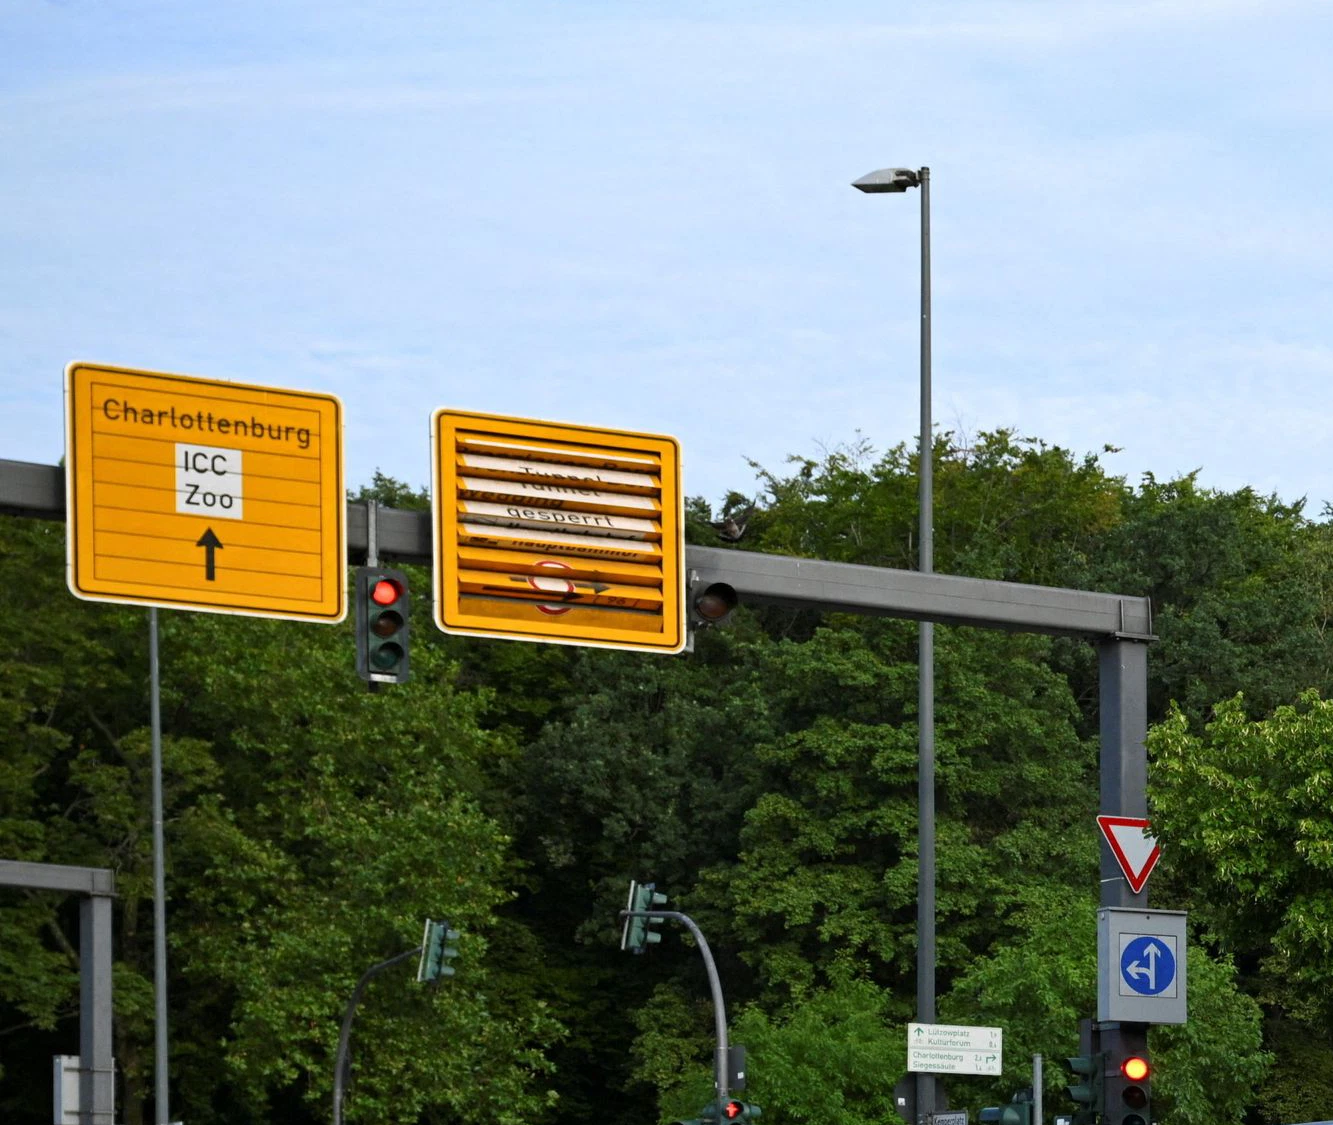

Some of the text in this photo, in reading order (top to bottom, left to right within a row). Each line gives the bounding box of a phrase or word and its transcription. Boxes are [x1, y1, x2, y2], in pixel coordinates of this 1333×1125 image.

[103, 398, 310, 449] Charlottenburg
[184, 451, 227, 476] ICC
[185, 483, 233, 509] Zoo
[506, 505, 614, 528] gesperrt
